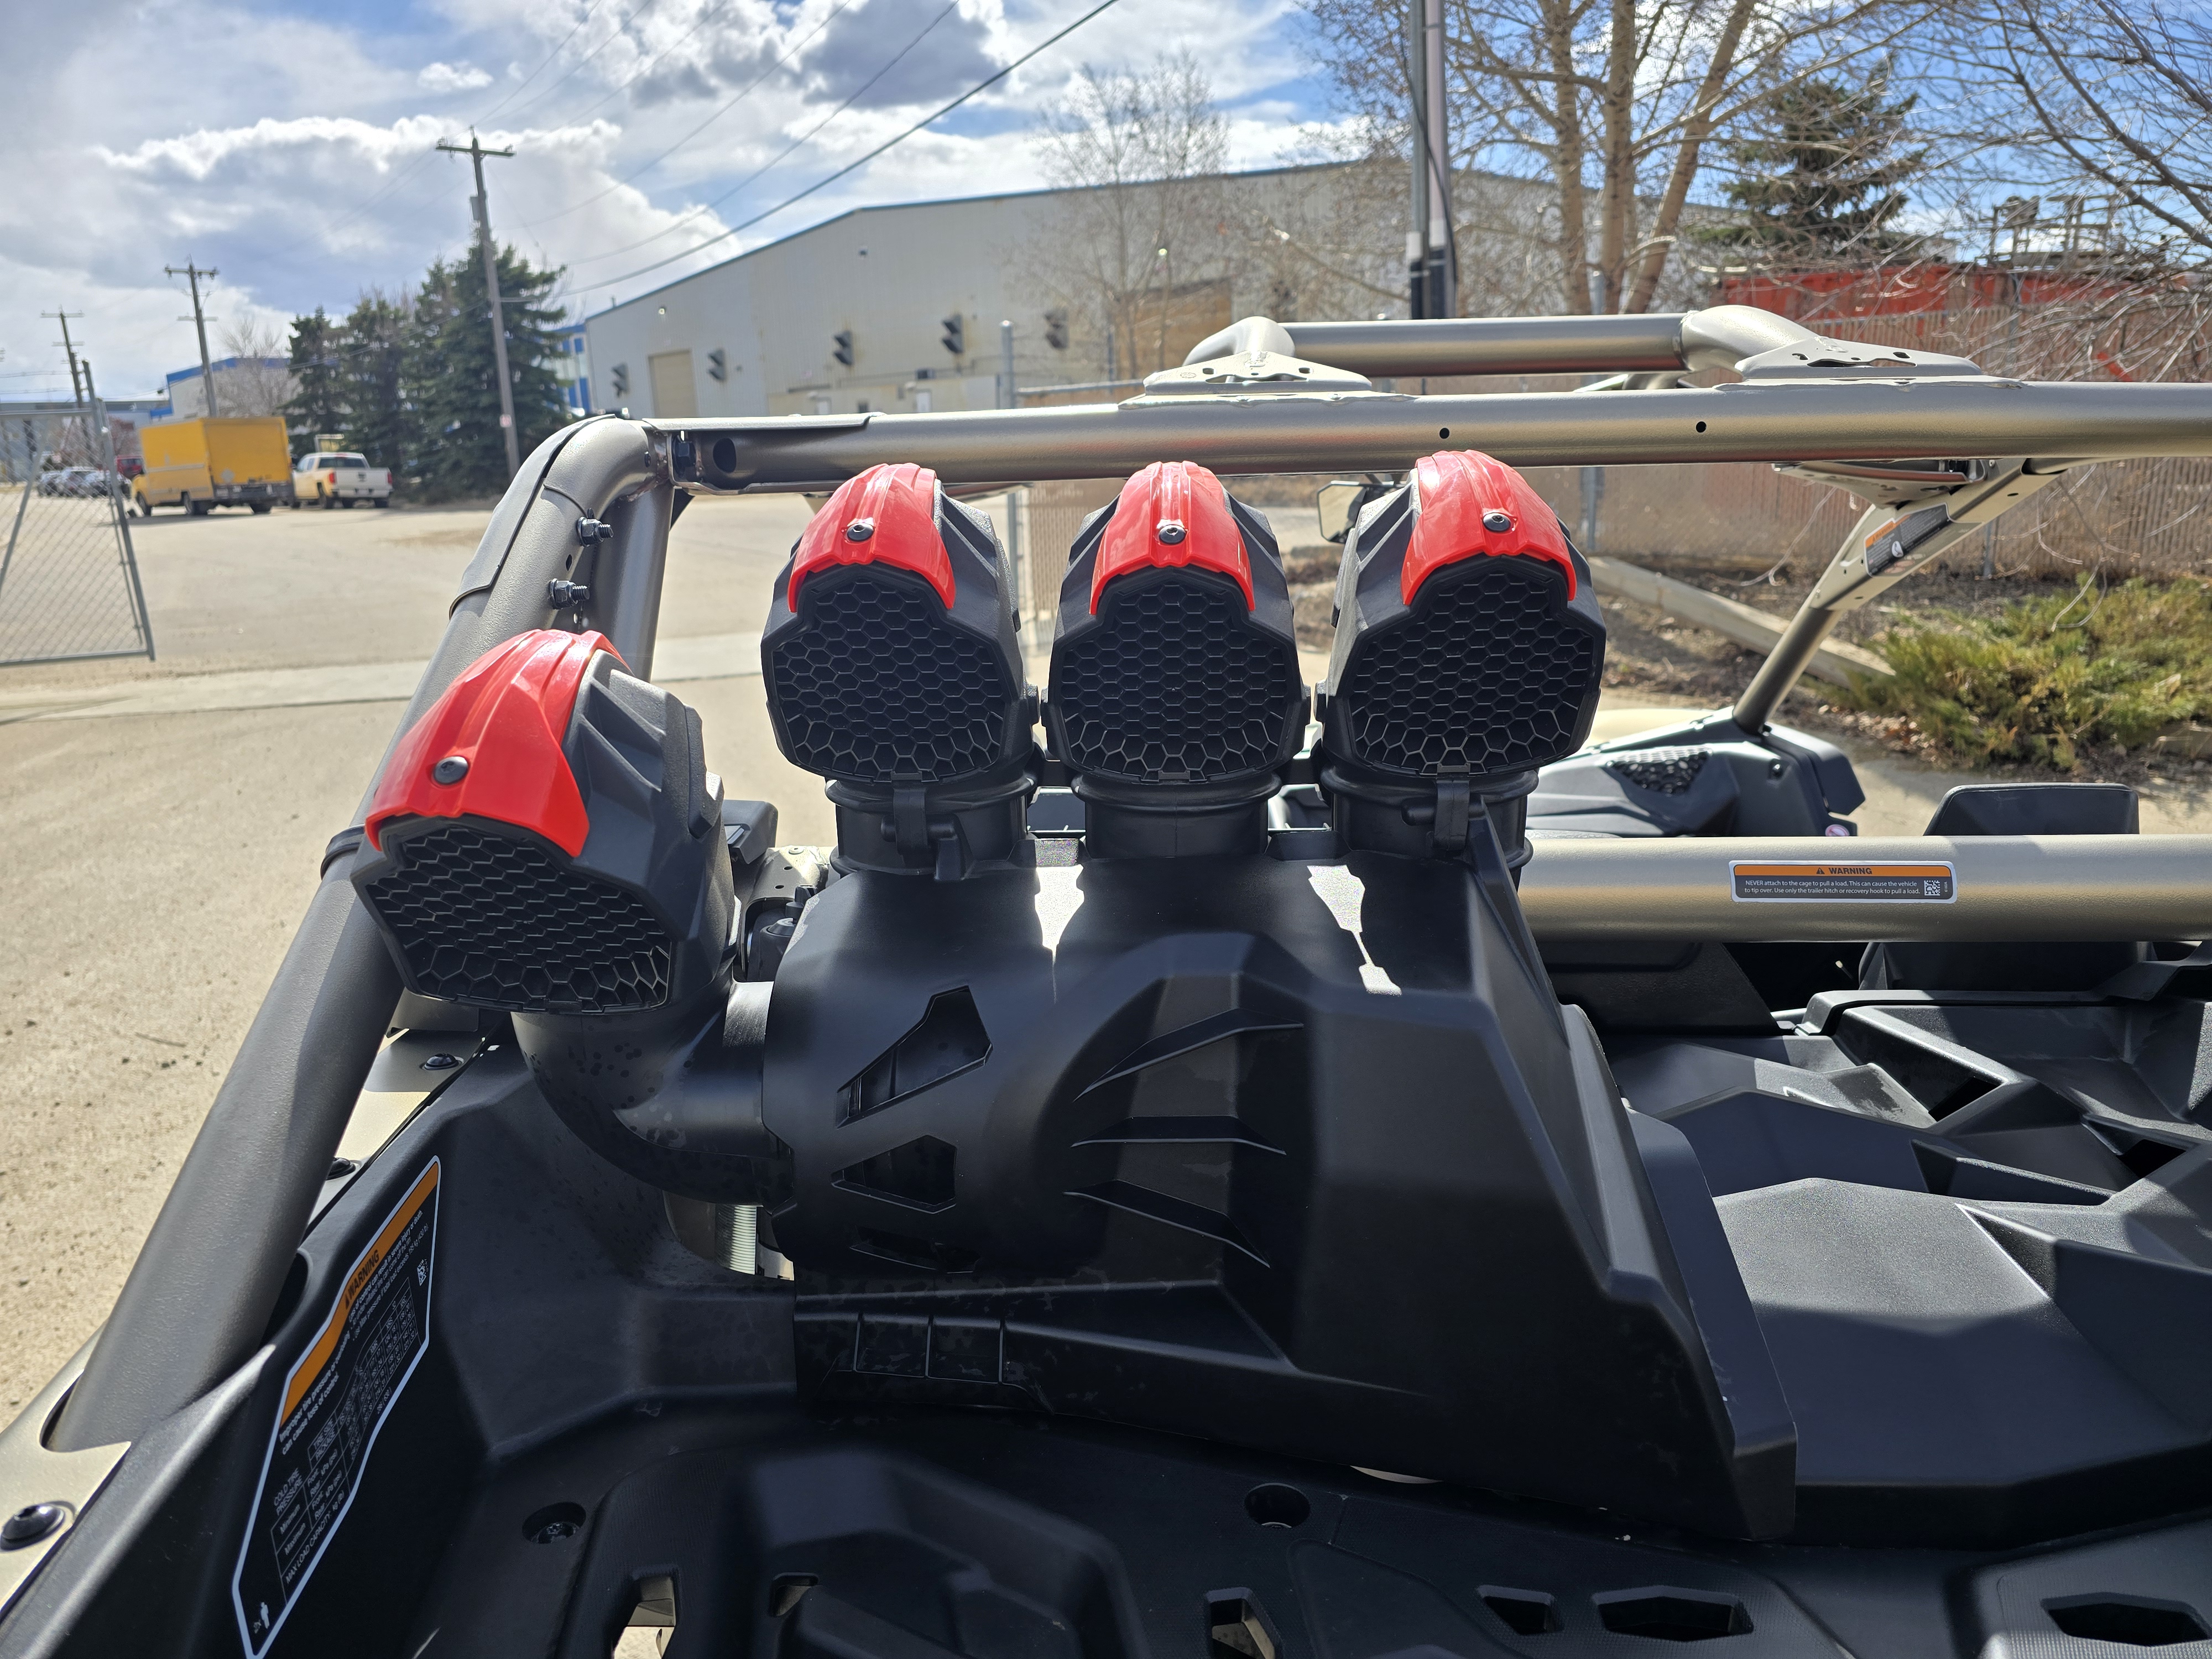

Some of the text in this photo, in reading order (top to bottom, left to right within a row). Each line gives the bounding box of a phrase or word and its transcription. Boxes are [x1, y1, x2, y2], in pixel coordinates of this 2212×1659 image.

[348, 1249, 380, 1300] WARNING
[355, 1298, 359, 1310] of
[359, 1282, 372, 1303] control
[378, 1259, 388, 1276] result
[391, 1240, 401, 1258] severe
[401, 1227, 410, 1243] injury
[389, 1257, 397, 1271] come
[367, 1295, 380, 1319] pressure
[279, 1408, 302, 1442] Improper
[302, 1397, 311, 1411] tire
[311, 1370, 331, 1401] pressure
[283, 1439, 293, 1455] can
[293, 1418, 307, 1441] cause
[307, 1404, 319, 1420] loss
[319, 1393, 324, 1405] of
[314, 1418, 333, 1449] TIRE SIZE
[274, 1468, 299, 1506] COLD TIRE
[276, 1475, 302, 1516] PRESSURE
[280, 1504, 300, 1534] Minimum
[321, 1463, 329, 1476] kPa
[284, 1523, 305, 1555] Maximum
[286, 1564, 298, 1584] MAX
[296, 1545, 310, 1567] LOAD
